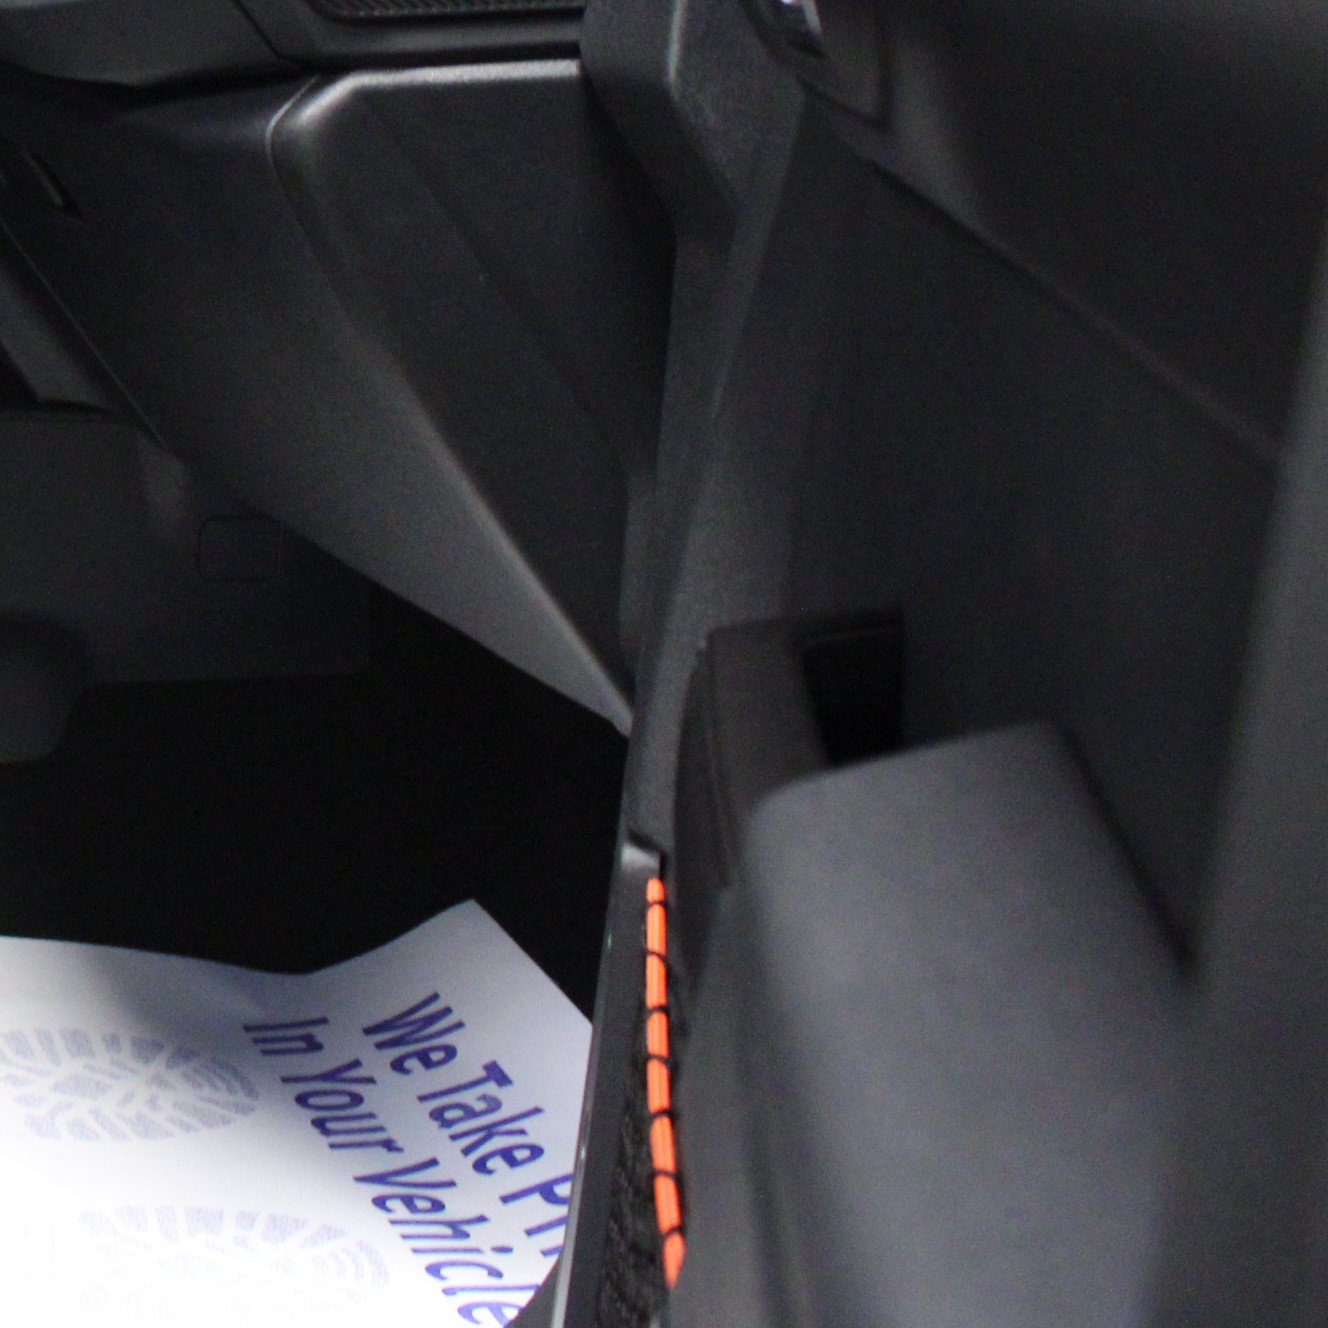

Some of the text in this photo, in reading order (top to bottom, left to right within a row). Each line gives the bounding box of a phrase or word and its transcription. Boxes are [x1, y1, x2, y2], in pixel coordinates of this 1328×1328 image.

[243, 1017, 329, 1057] In
[362, 992, 465, 1076] We
[416, 1060, 544, 1176] Take
[279, 1058, 405, 1154] Your
